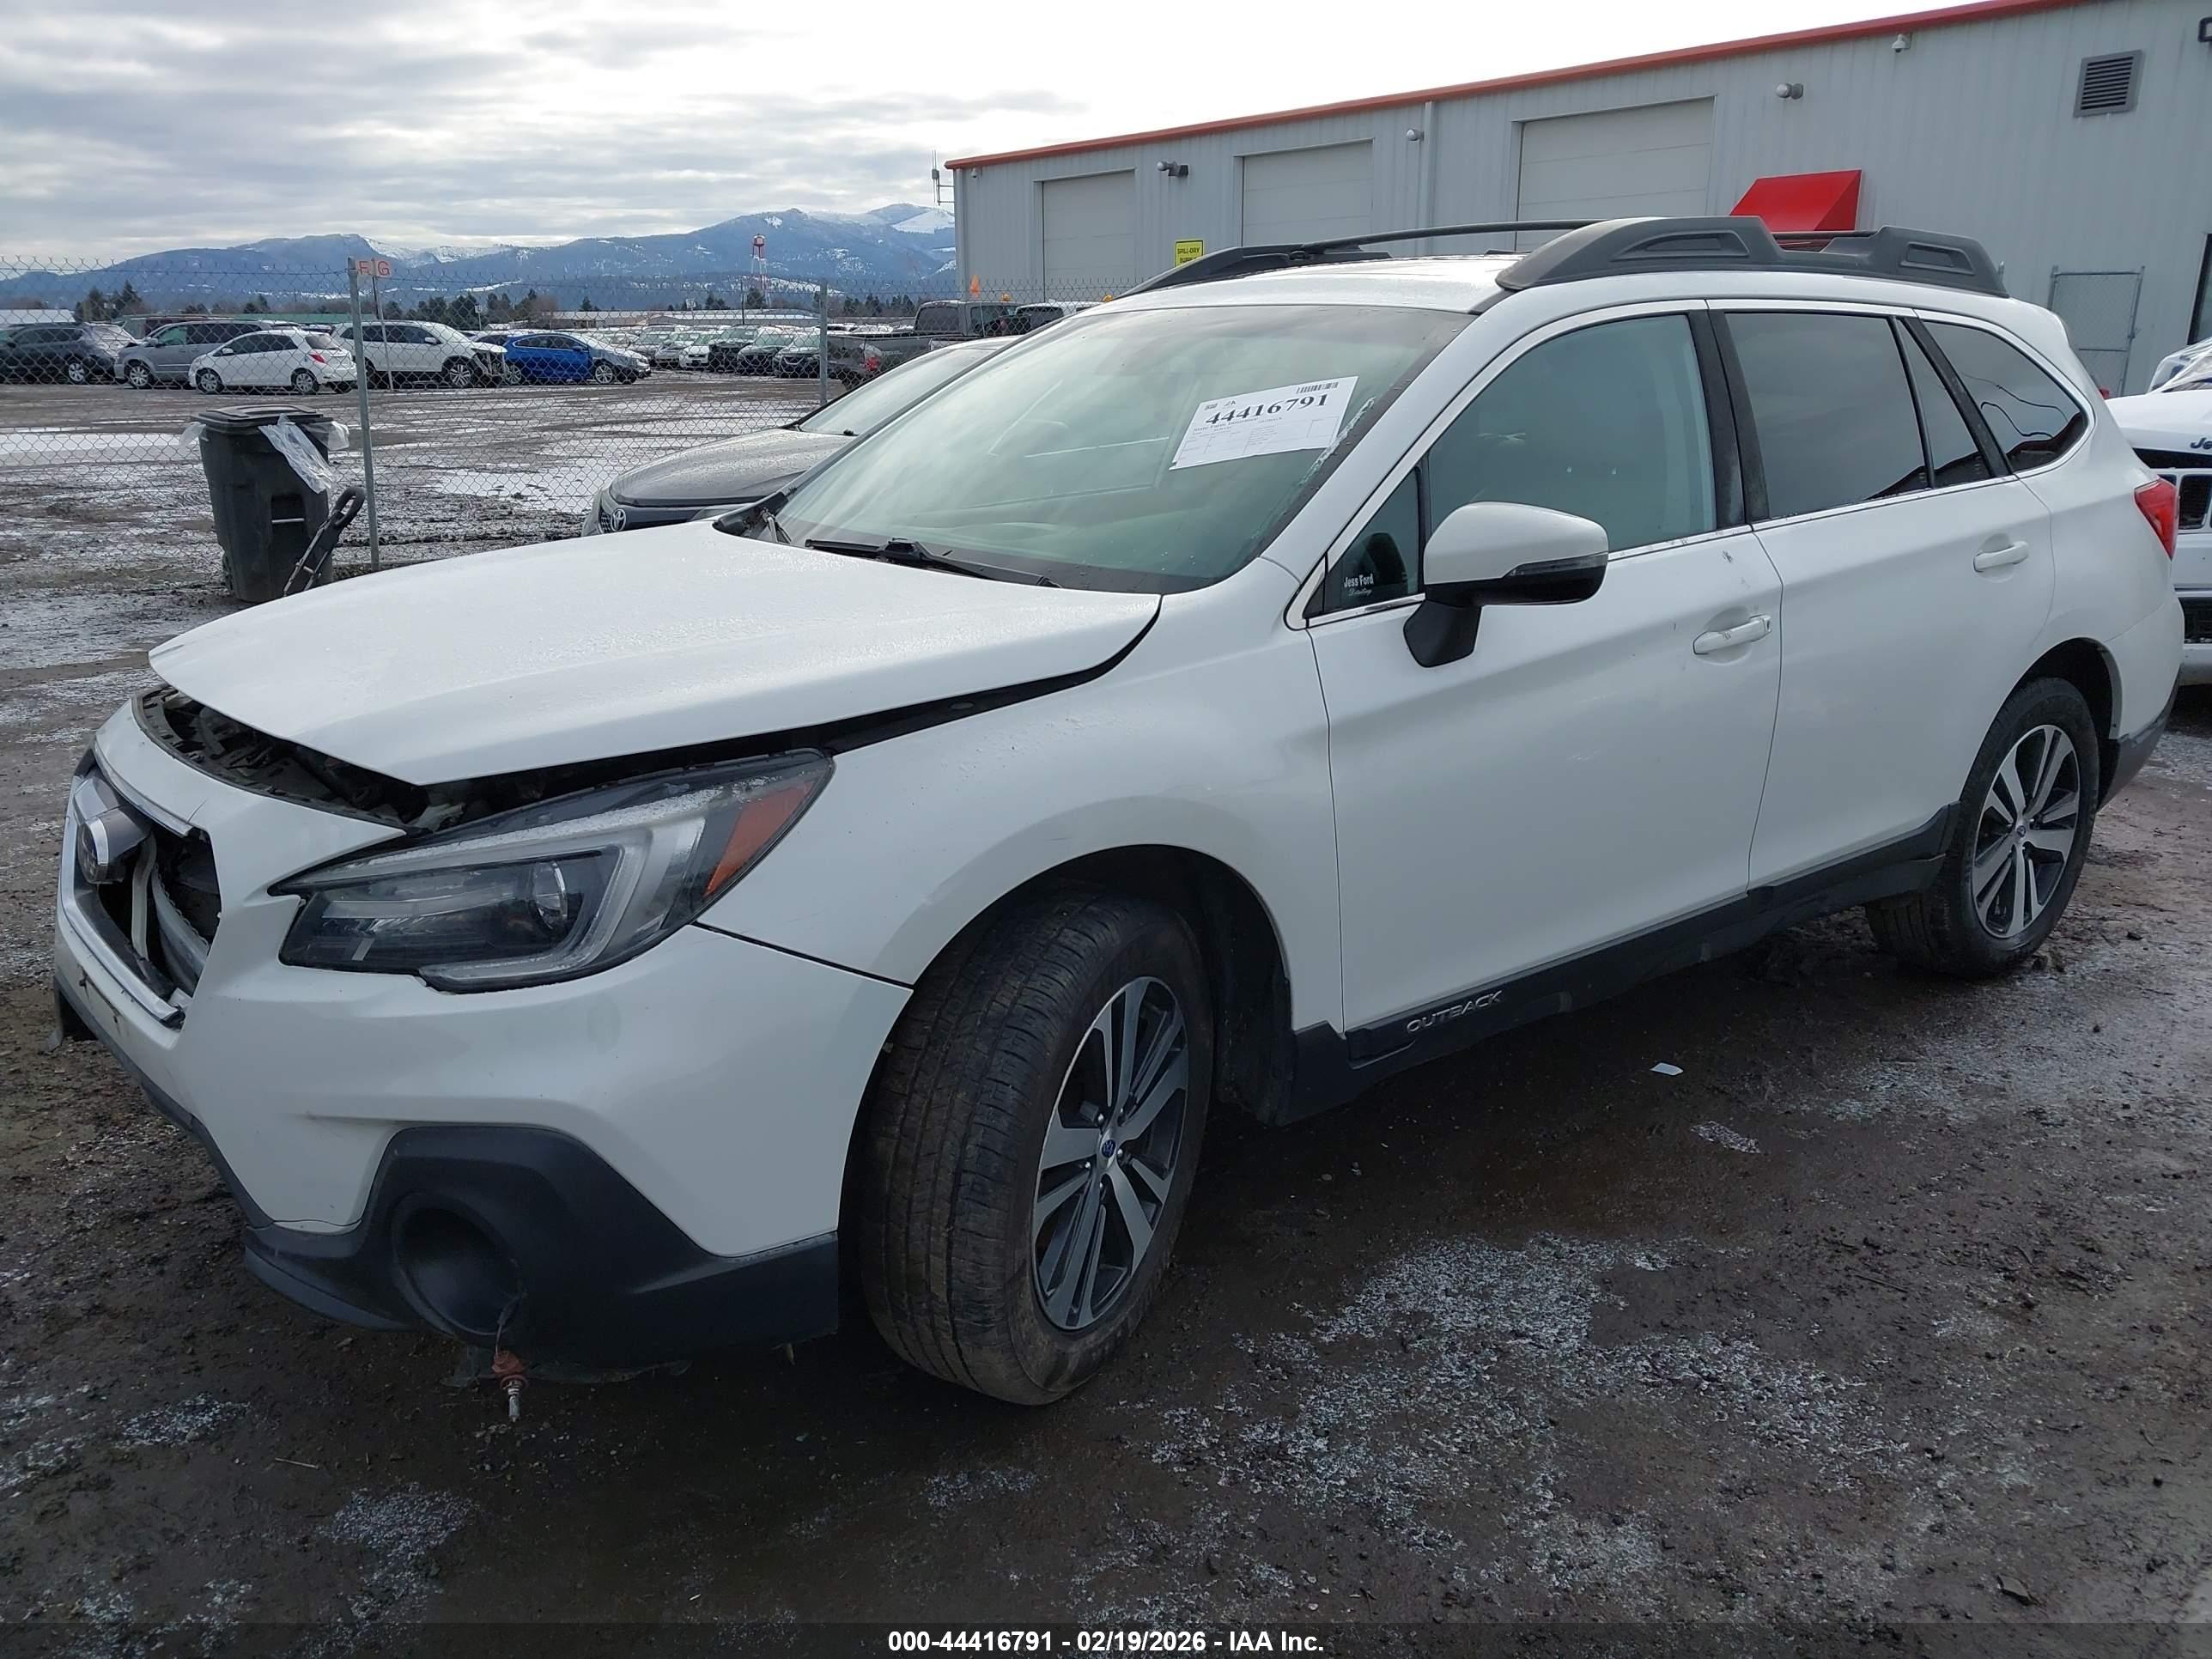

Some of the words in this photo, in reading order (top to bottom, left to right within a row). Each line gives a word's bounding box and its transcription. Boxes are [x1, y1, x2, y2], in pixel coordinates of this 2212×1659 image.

[378, 260, 391, 276] G
[1206, 393, 1328, 425] 44416791
[1344, 576, 1358, 587] Jess
[1358, 573, 1374, 585] Ford
[1407, 990, 1503, 1033] OUTBACK
